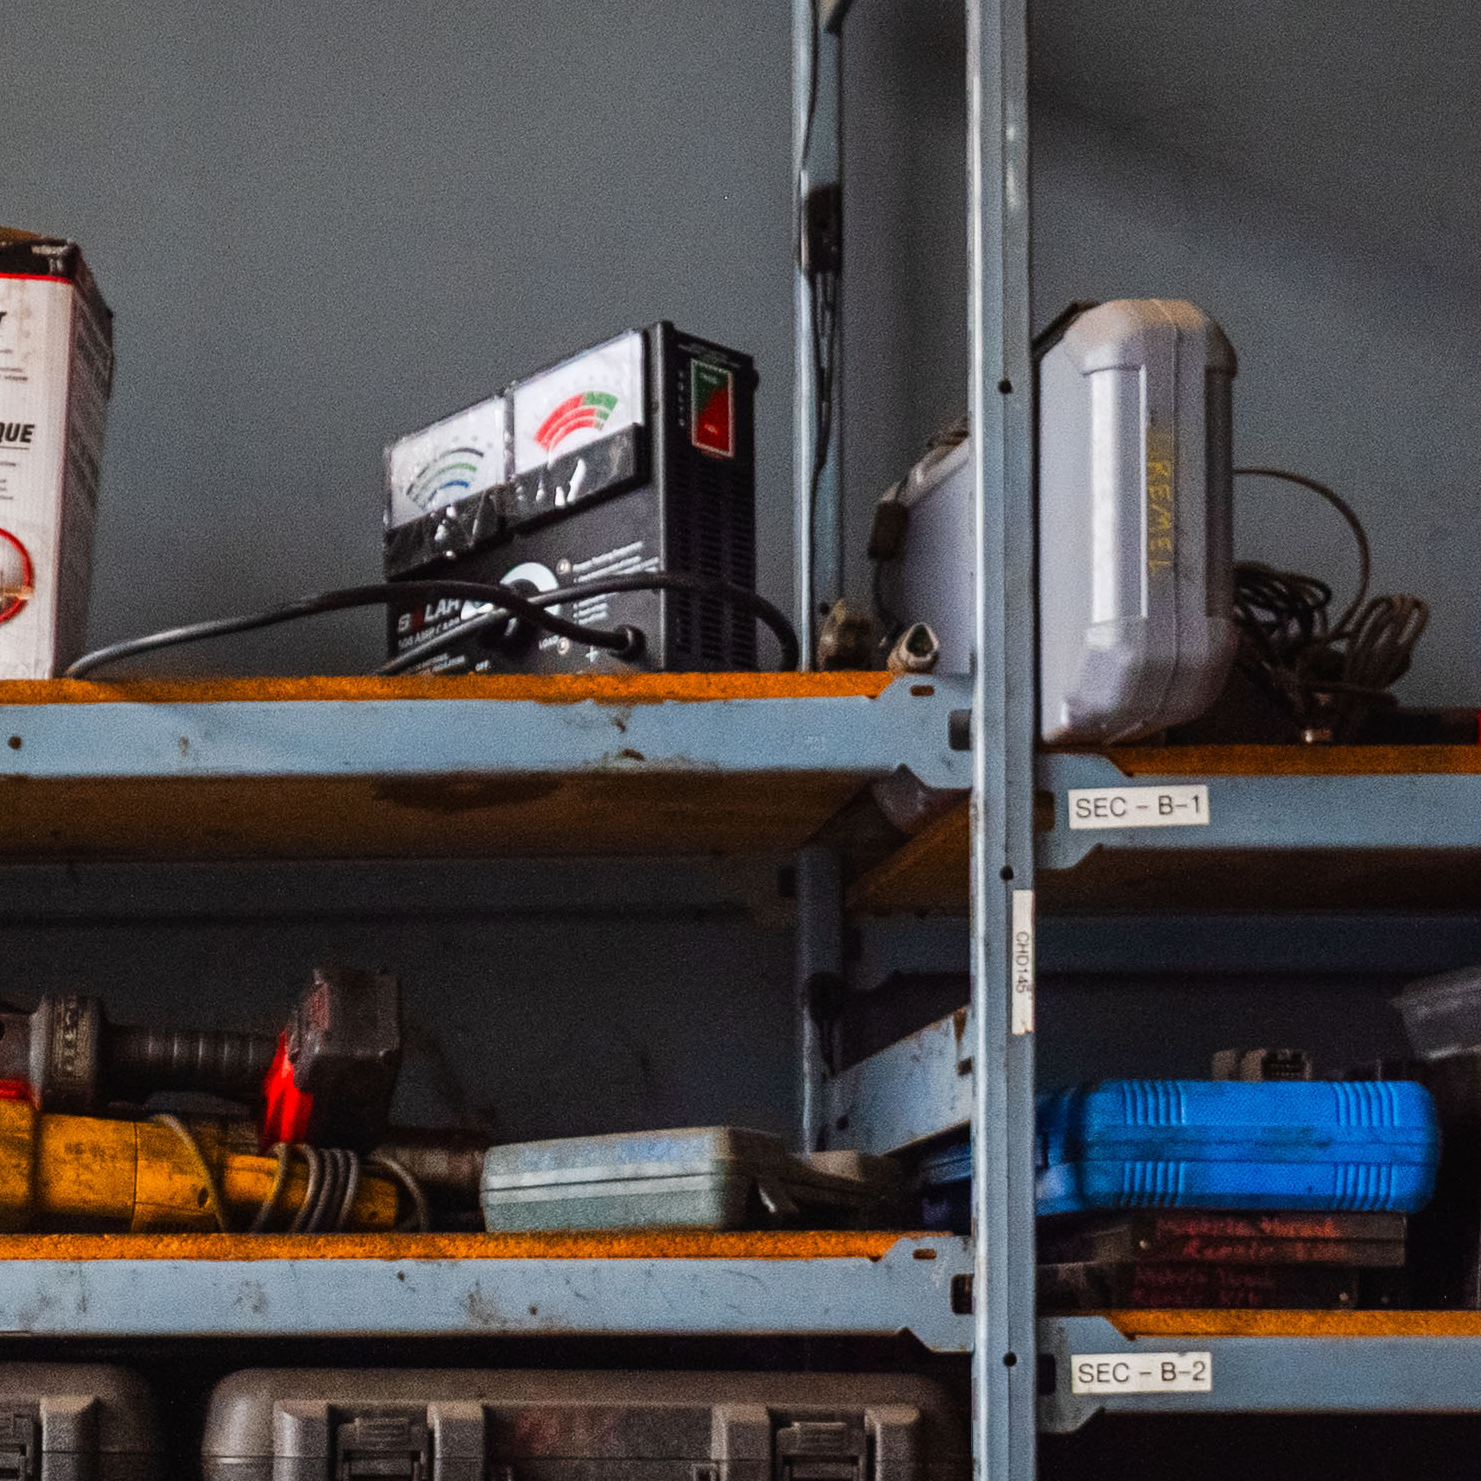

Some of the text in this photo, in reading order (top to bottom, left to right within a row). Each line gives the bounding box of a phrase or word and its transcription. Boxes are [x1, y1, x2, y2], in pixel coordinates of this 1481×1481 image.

[1076, 796, 1127, 818] SEC
[1158, 795, 1200, 816] B-1
[1078, 1362, 1130, 1384] SEC
[1161, 1360, 1206, 1382] B-2
